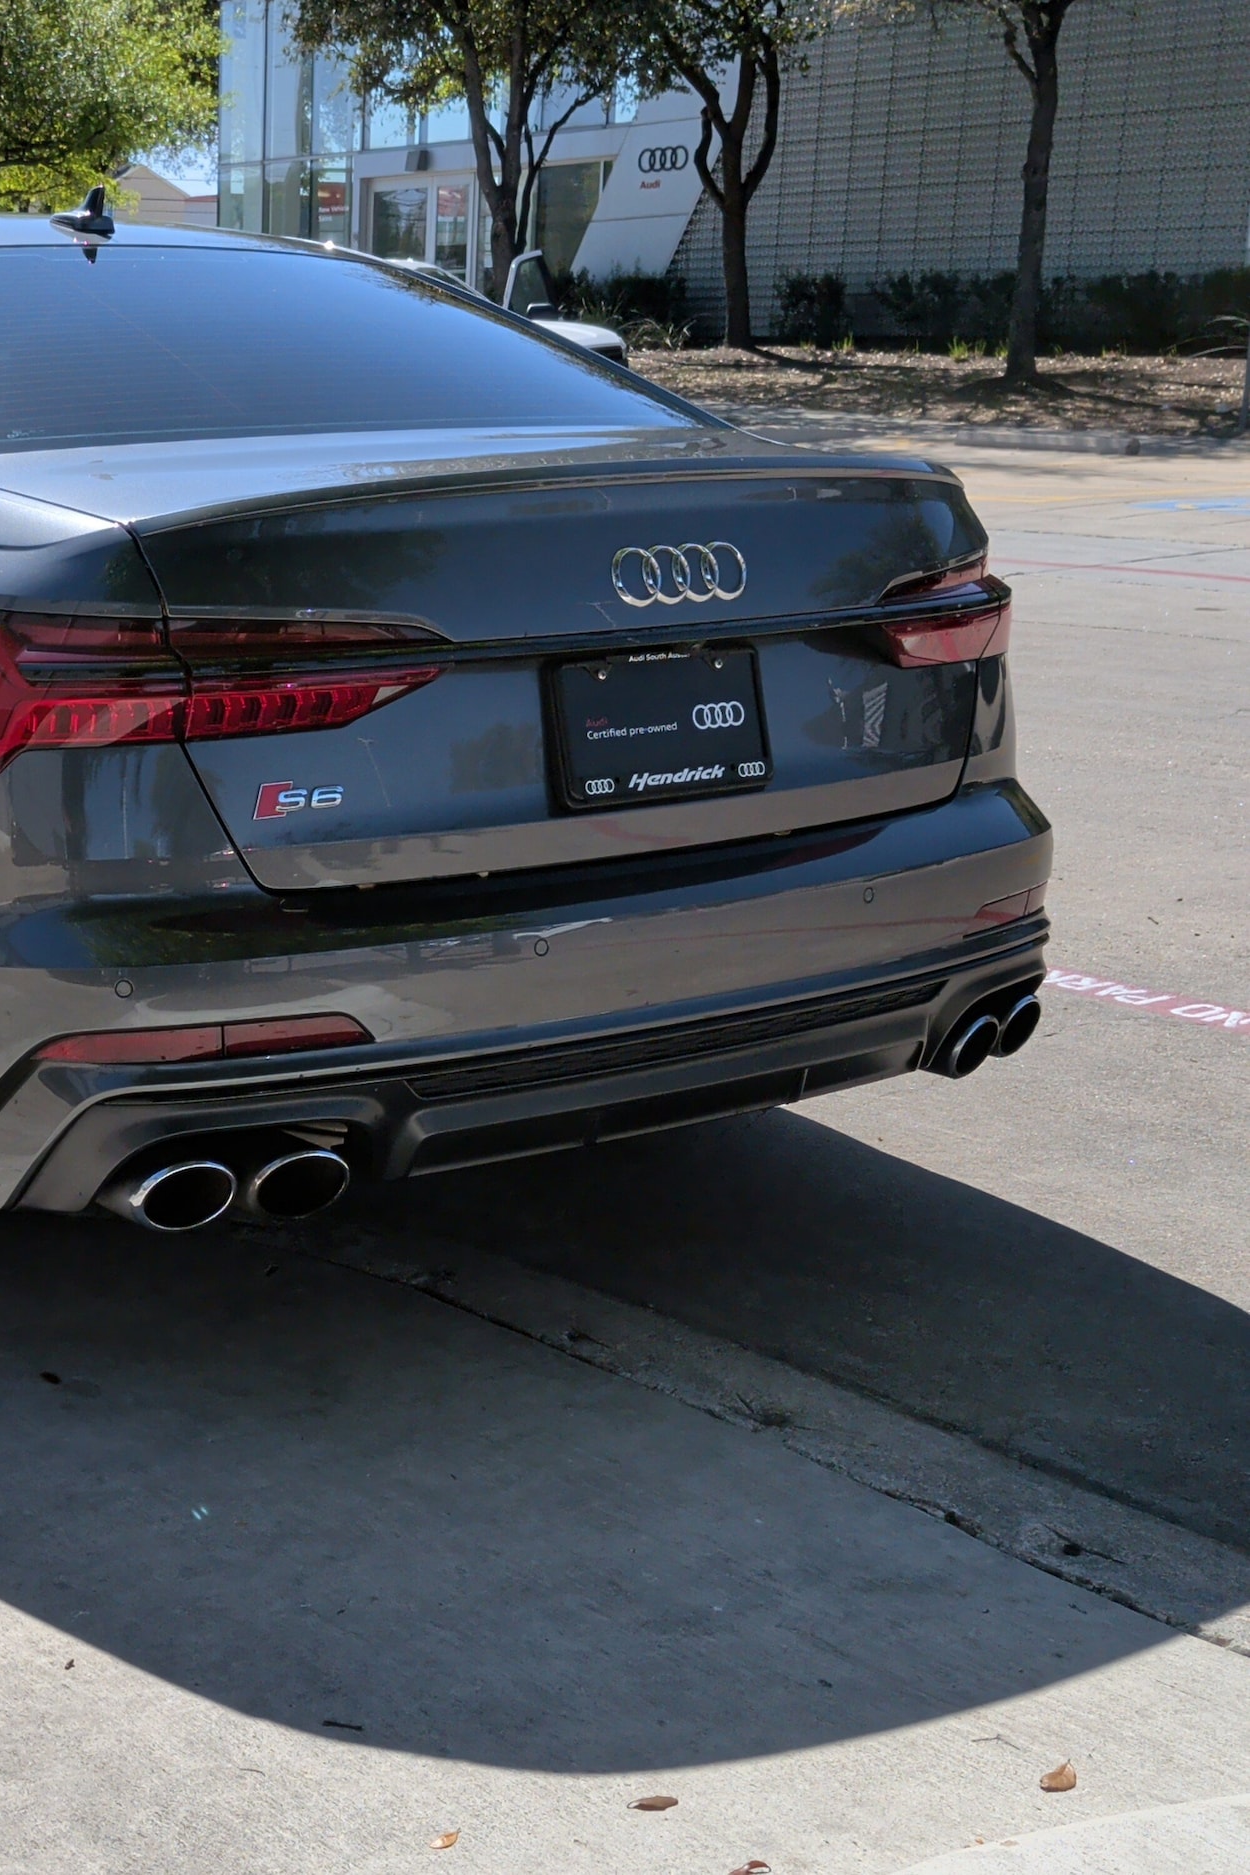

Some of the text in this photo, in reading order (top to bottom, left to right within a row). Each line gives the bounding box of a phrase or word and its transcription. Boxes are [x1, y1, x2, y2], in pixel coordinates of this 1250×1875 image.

[640, 179, 661, 190] Audi
[628, 655, 645, 663] Audi
[645, 653, 667, 662] South
[586, 717, 608, 727] Audi
[586, 722, 678, 740] Certified pre-owned
[627, 764, 726, 792] Hendrick
[274, 784, 344, 813] S6
